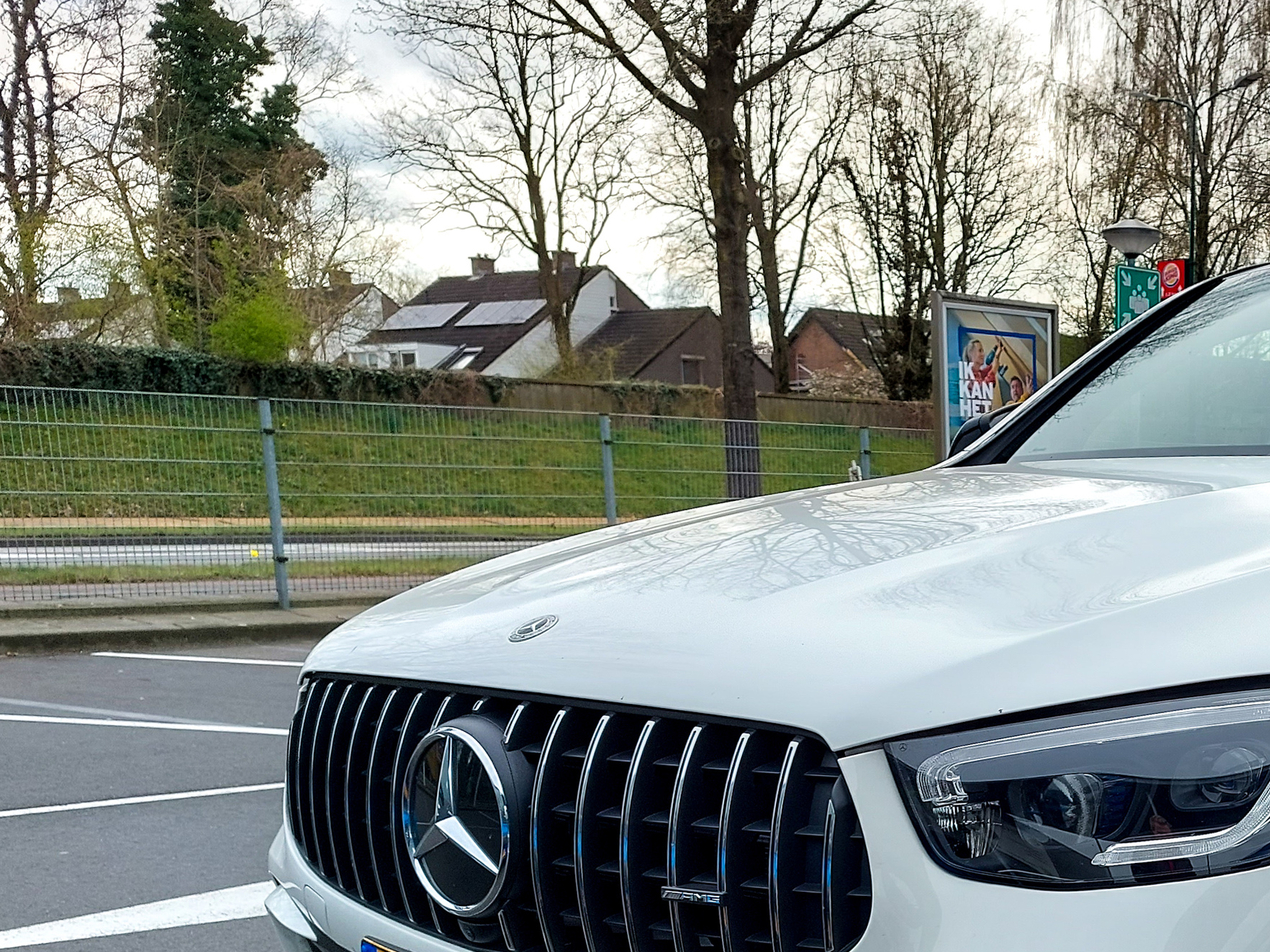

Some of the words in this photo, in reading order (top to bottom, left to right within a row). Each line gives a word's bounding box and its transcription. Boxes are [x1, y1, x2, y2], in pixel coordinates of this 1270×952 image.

[959, 361, 976, 380] IK
[960, 380, 994, 399] KAN
[960, 399, 992, 417] HET
